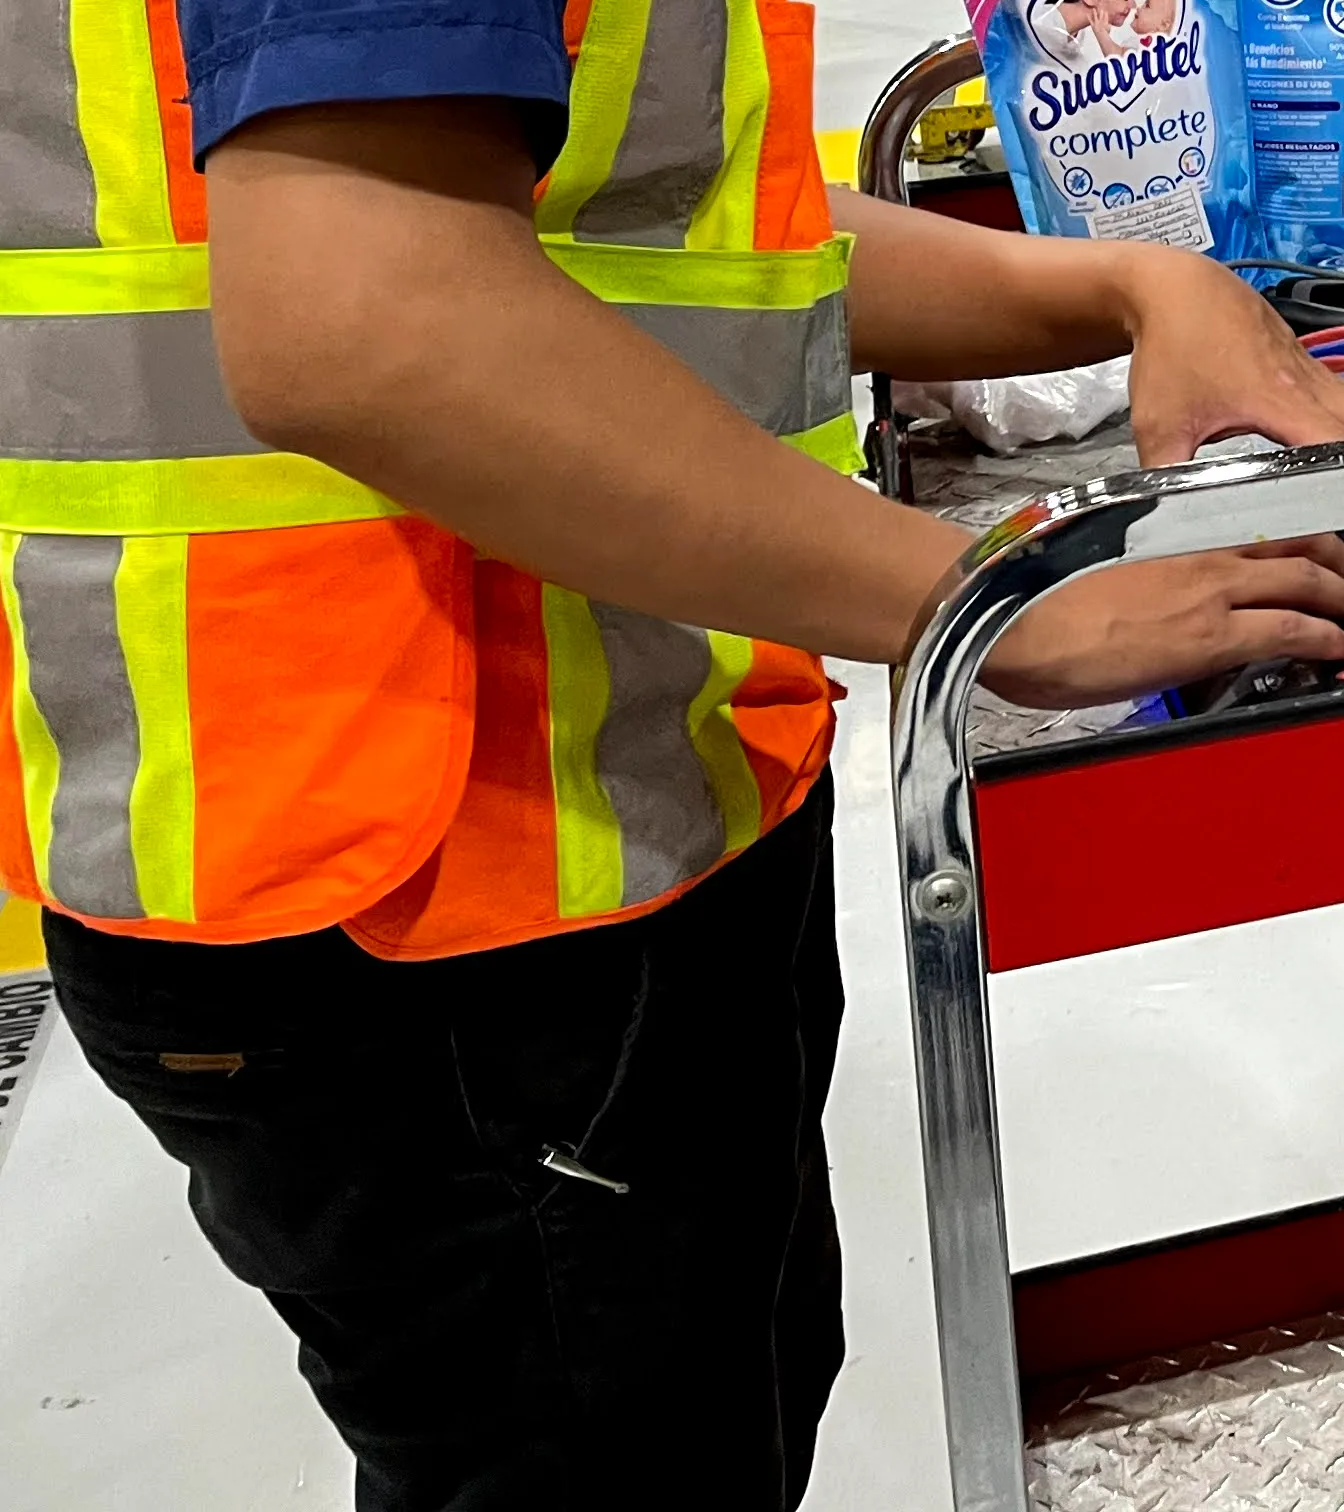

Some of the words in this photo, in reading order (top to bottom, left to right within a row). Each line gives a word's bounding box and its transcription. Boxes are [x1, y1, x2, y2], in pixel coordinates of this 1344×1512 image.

[1250, 43, 1295, 56] Beneficios
[1029, 20, 1202, 132] Suavitel
[1049, 109, 1207, 160] complete
